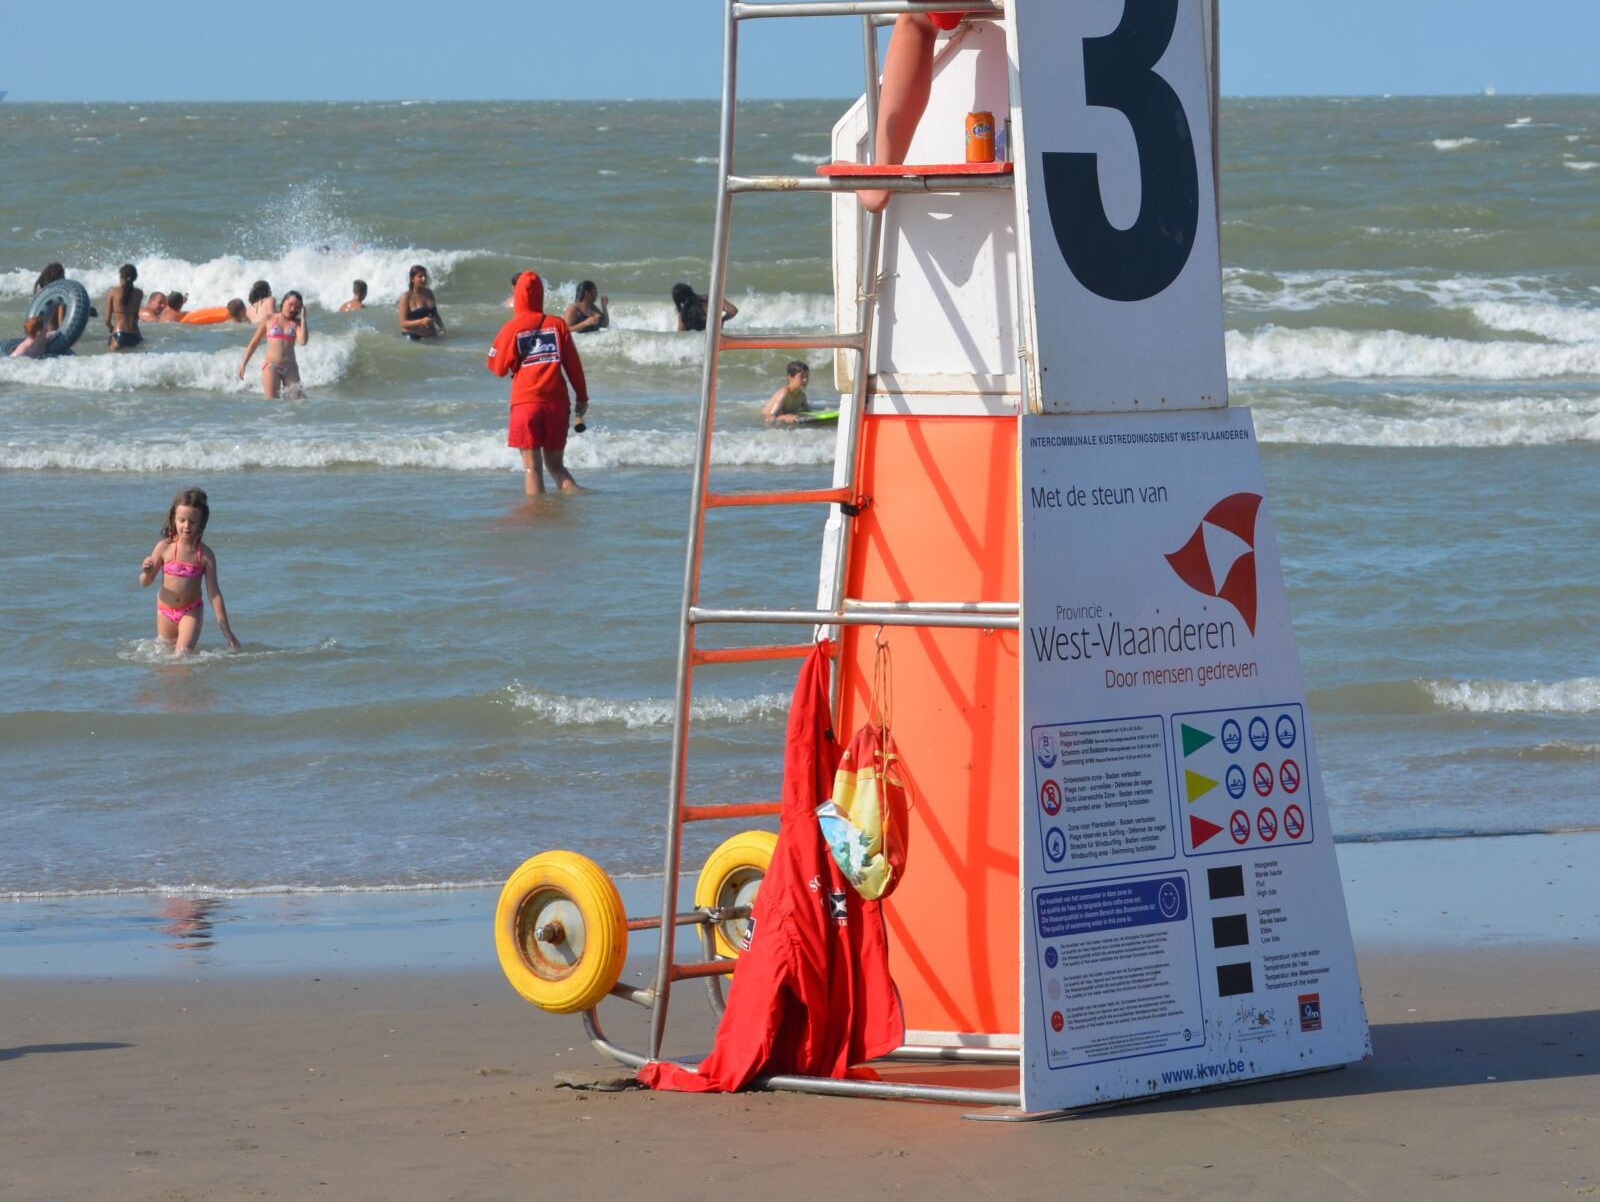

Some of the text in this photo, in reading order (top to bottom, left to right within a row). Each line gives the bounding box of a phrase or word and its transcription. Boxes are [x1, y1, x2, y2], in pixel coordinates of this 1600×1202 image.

[1030, 429, 1249, 447] INTERCOMMUNALE KUSTREDDINGSDIENST WEST-VLAANDEREN
[1031, 484, 1168, 509] Met de steun van
[1056, 604, 1103, 621] Provincie
[1030, 617, 1236, 662] West-Vlaanderen
[1105, 660, 1258, 689] Door mensen gedreven
[1109, 829, 1125, 837] Surfing
[1257, 890, 1268, 898] High
[1162, 1059, 1245, 1085] www.ikwv.be
